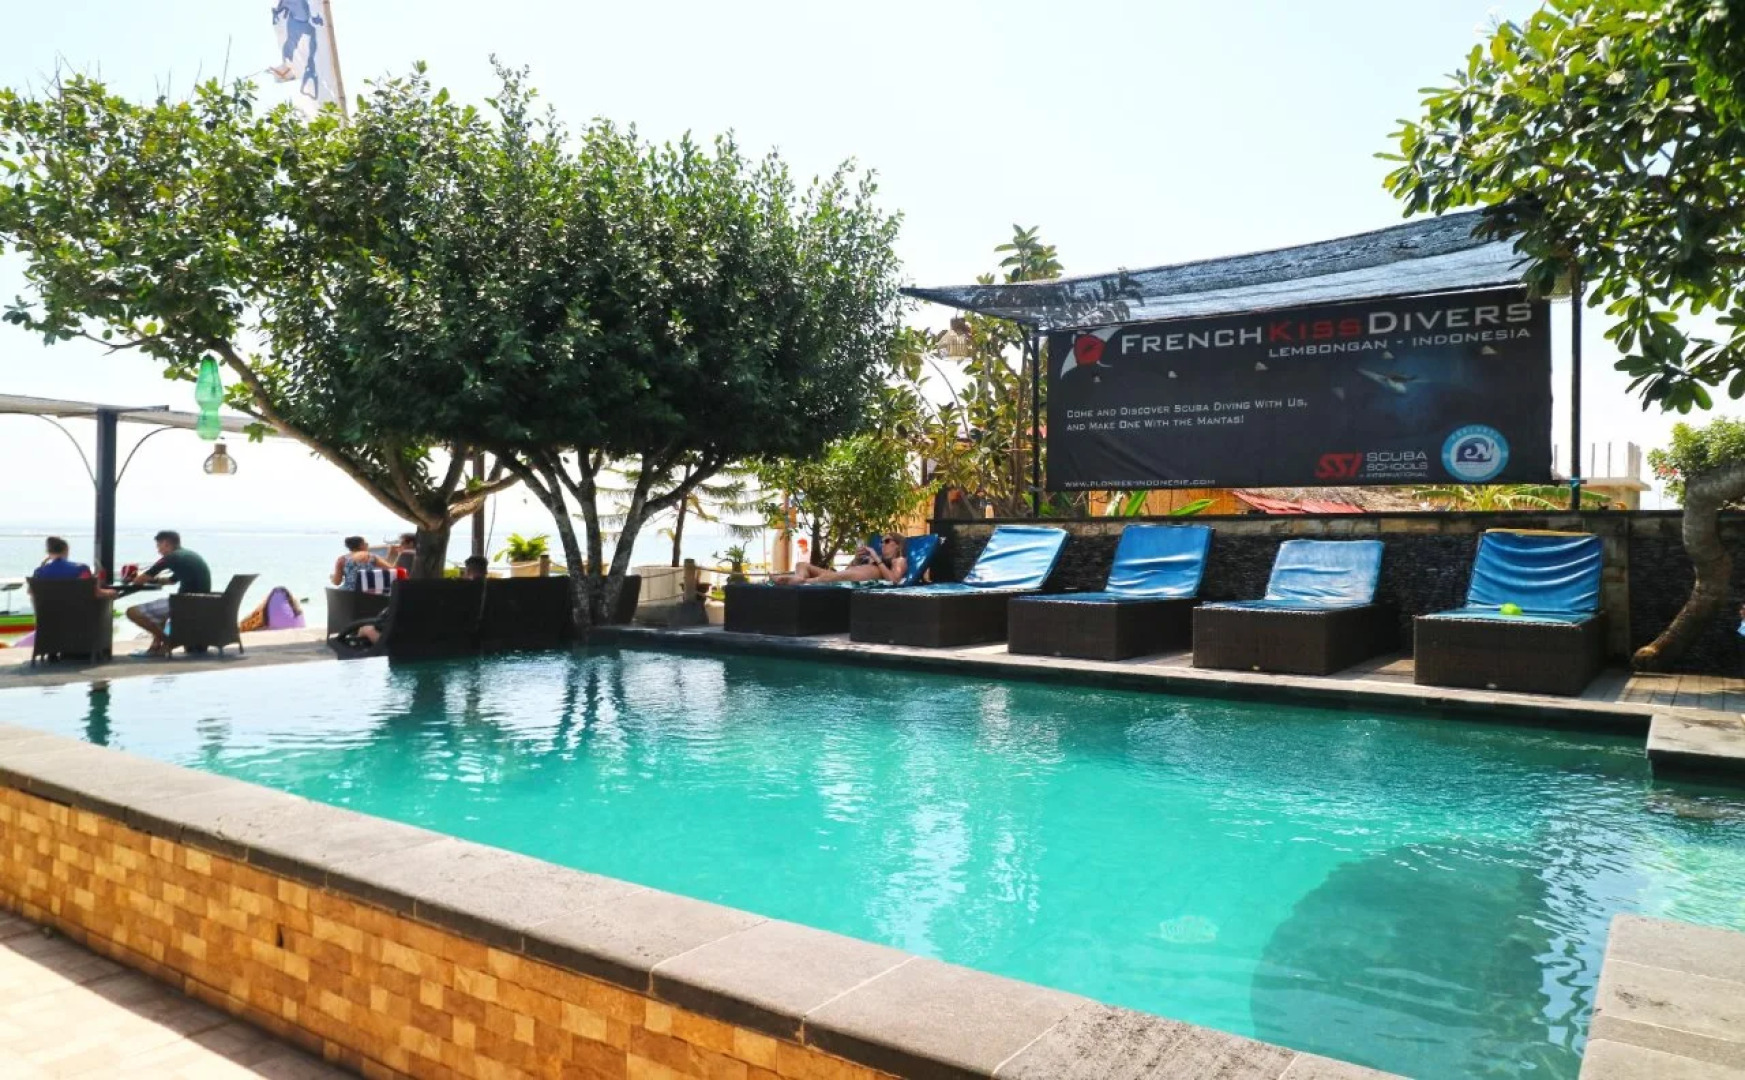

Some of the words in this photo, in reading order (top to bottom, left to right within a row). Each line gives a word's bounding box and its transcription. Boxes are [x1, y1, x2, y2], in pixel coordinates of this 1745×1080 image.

[1268, 340, 1388, 358] LEMBONGAN
[1412, 328, 1531, 348] INDONESIA
[1097, 409, 1117, 417] AND
[1120, 406, 1170, 416] DISCOVER
[1174, 404, 1209, 413] SCUBA
[1214, 401, 1251, 412] DIVING
[1255, 400, 1283, 409] WITH
[1066, 423, 1086, 432] AND
[1089, 422, 1117, 431] MAKE
[1119, 420, 1141, 429] ONE
[1144, 419, 1169, 428] WITH
[1173, 418, 1193, 427] THE
[1366, 451, 1427, 462] SCUBA
[1314, 452, 1363, 478] SSI
[1366, 462, 1428, 471] SCHOOLS
